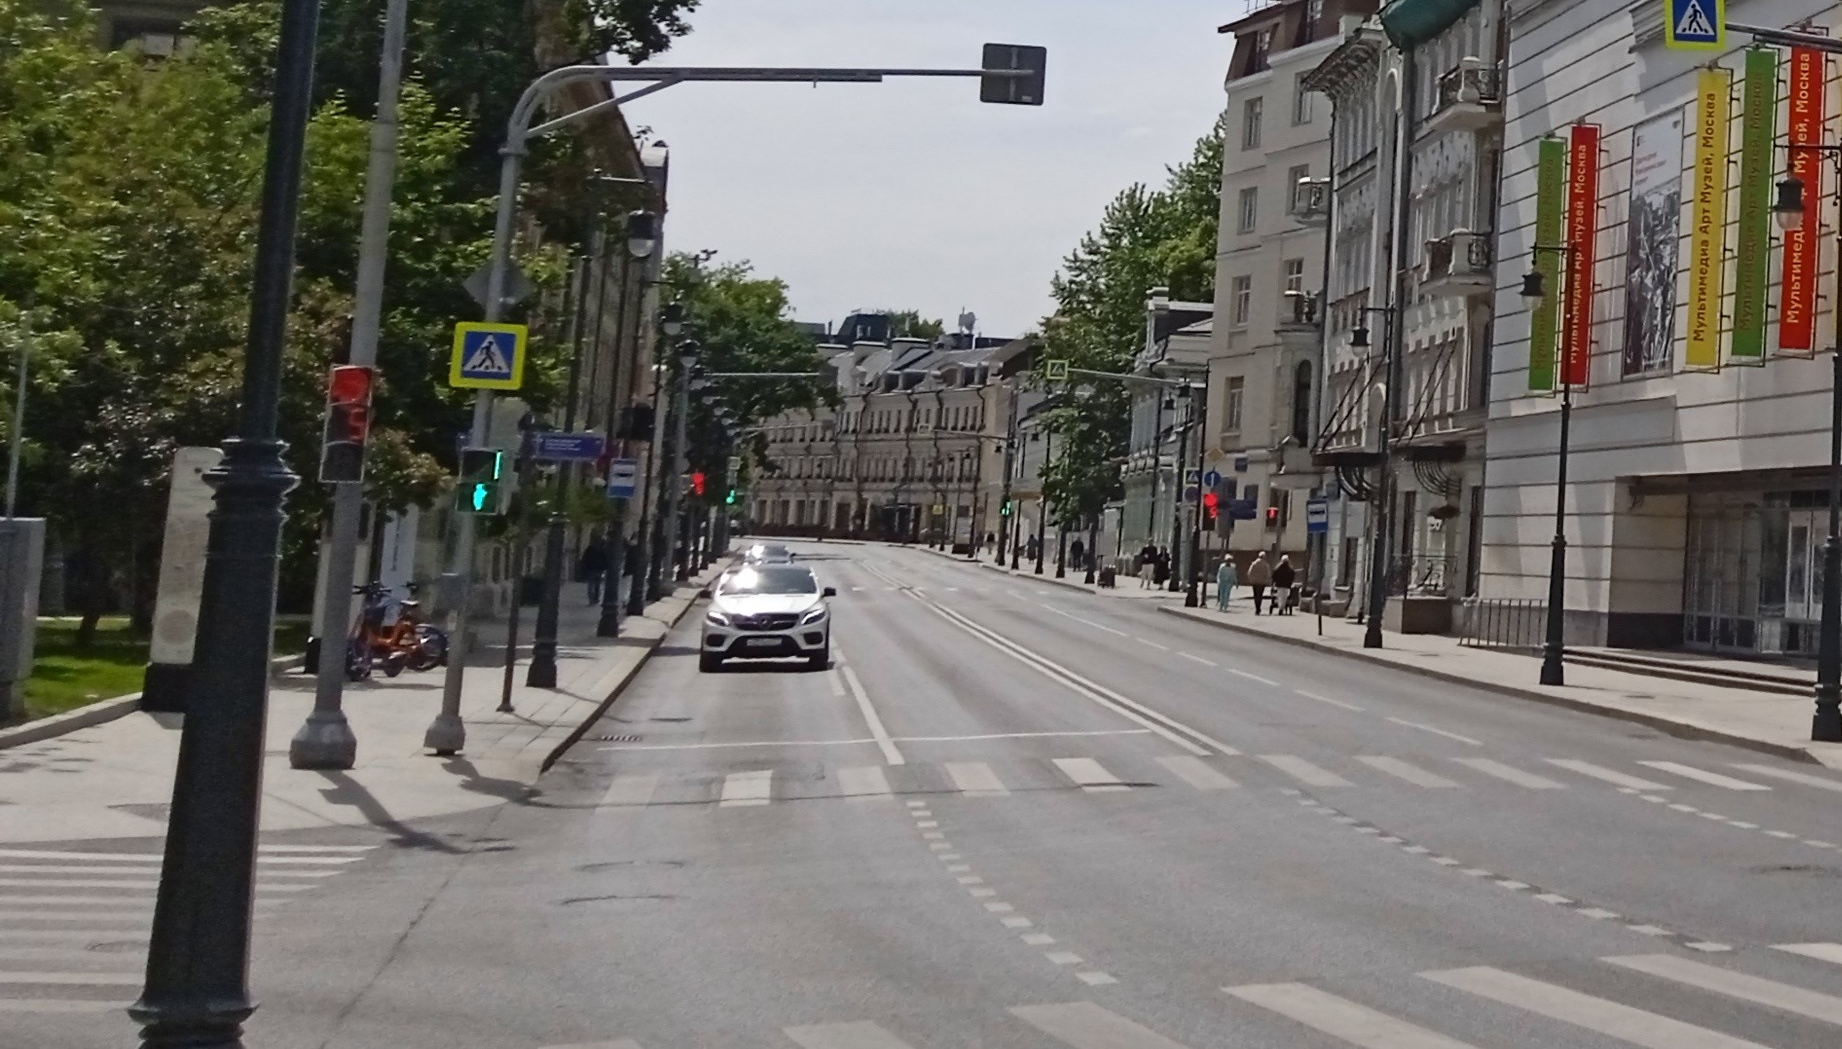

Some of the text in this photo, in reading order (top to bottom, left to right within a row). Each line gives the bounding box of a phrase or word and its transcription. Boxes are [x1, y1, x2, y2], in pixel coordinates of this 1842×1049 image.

[1795, 53, 1810, 113] Москва
[1575, 144, 1587, 194] Москва
[1693, 93, 1716, 342] Мультимедиа Арт Музей, Москва
